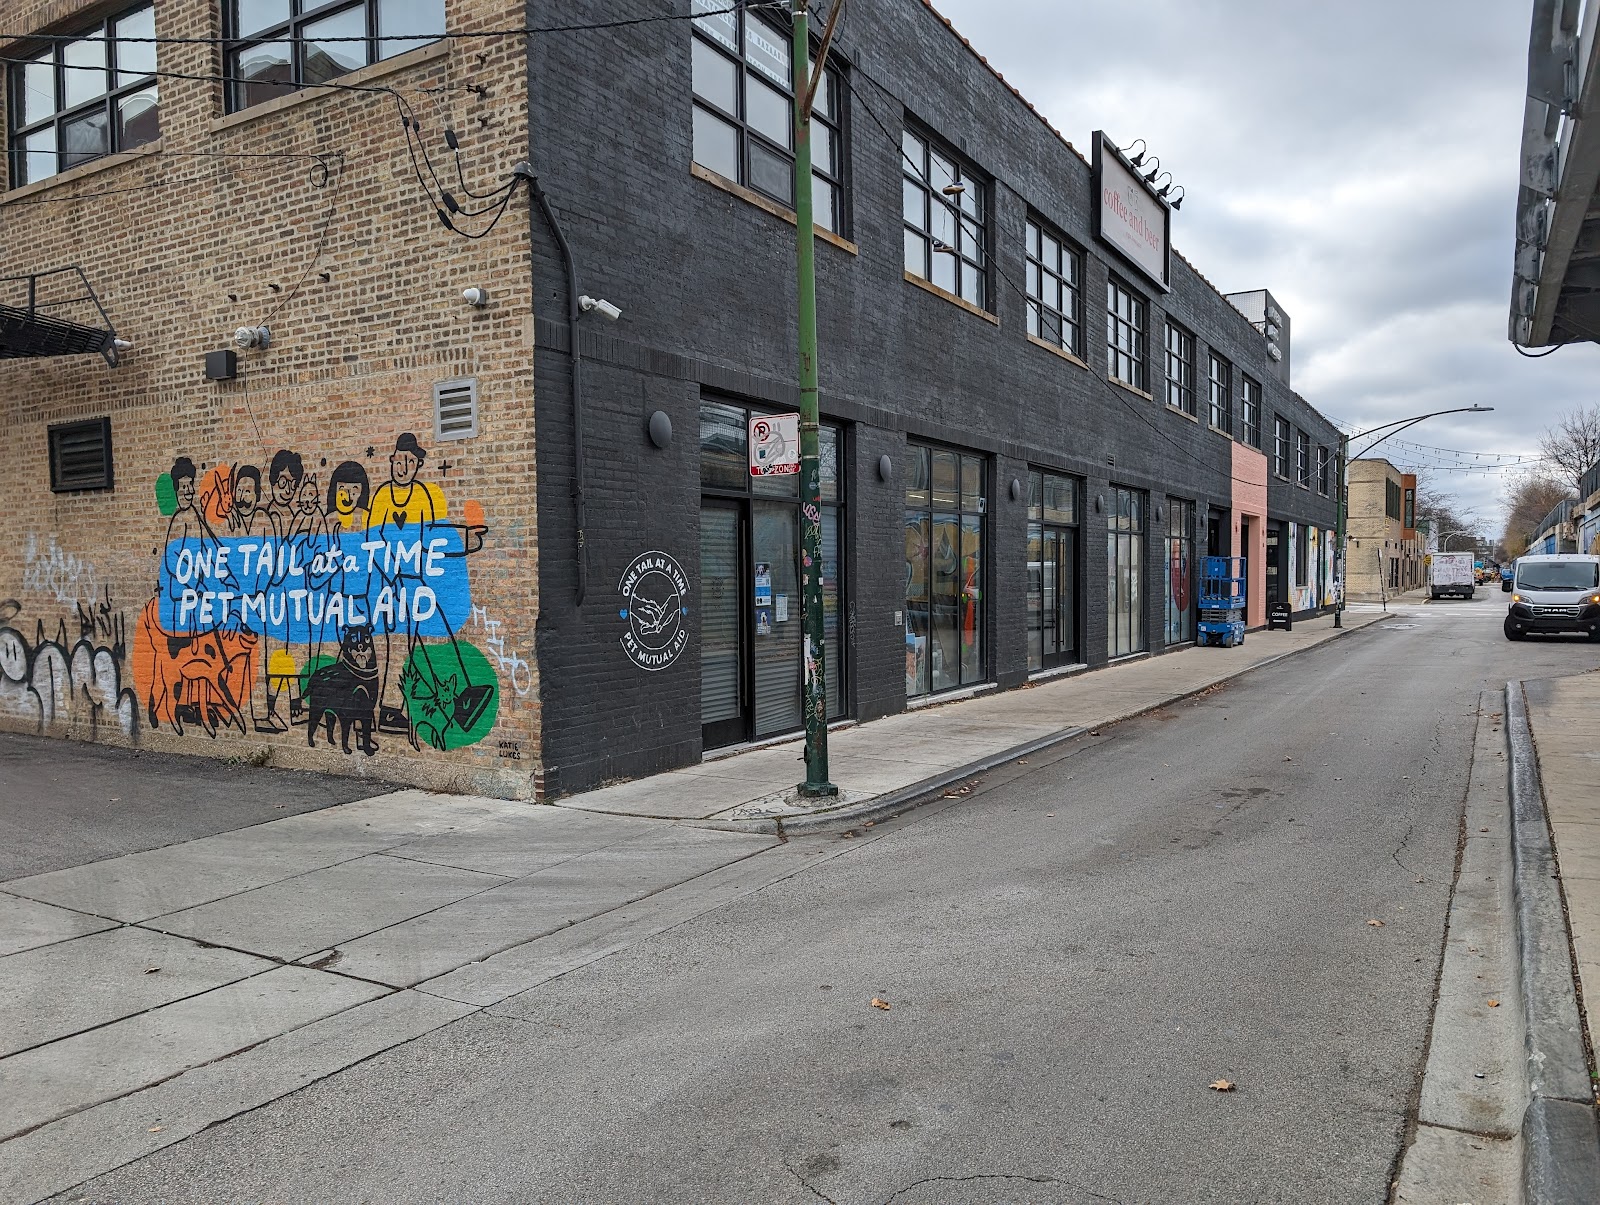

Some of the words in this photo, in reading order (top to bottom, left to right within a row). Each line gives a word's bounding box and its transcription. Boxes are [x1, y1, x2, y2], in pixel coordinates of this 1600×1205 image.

[1104, 188, 1127, 222] coffee
[1129, 211, 1143, 236] and
[1144, 220, 1159, 252] beer
[176, 547, 231, 584] ONE
[238, 542, 304, 577] TAIL
[312, 544, 342, 573] at
[343, 554, 360, 573] a
[361, 538, 448, 577] TIME
[622, 571, 638, 597] ONE
[636, 558, 654, 573] TAIL
[655, 558, 666, 570] AT
[665, 563, 672, 574] A
[672, 569, 687, 596] TIME
[179, 588, 235, 626] PET
[241, 589, 366, 627] MUTUAL
[373, 586, 436, 625] AID
[624, 632, 638, 653] PET
[637, 650, 673, 665] MUTUAL
[674, 629, 686, 651] AID
[499, 740, 518, 751] KATIE
[499, 750, 520, 760] LUKES
